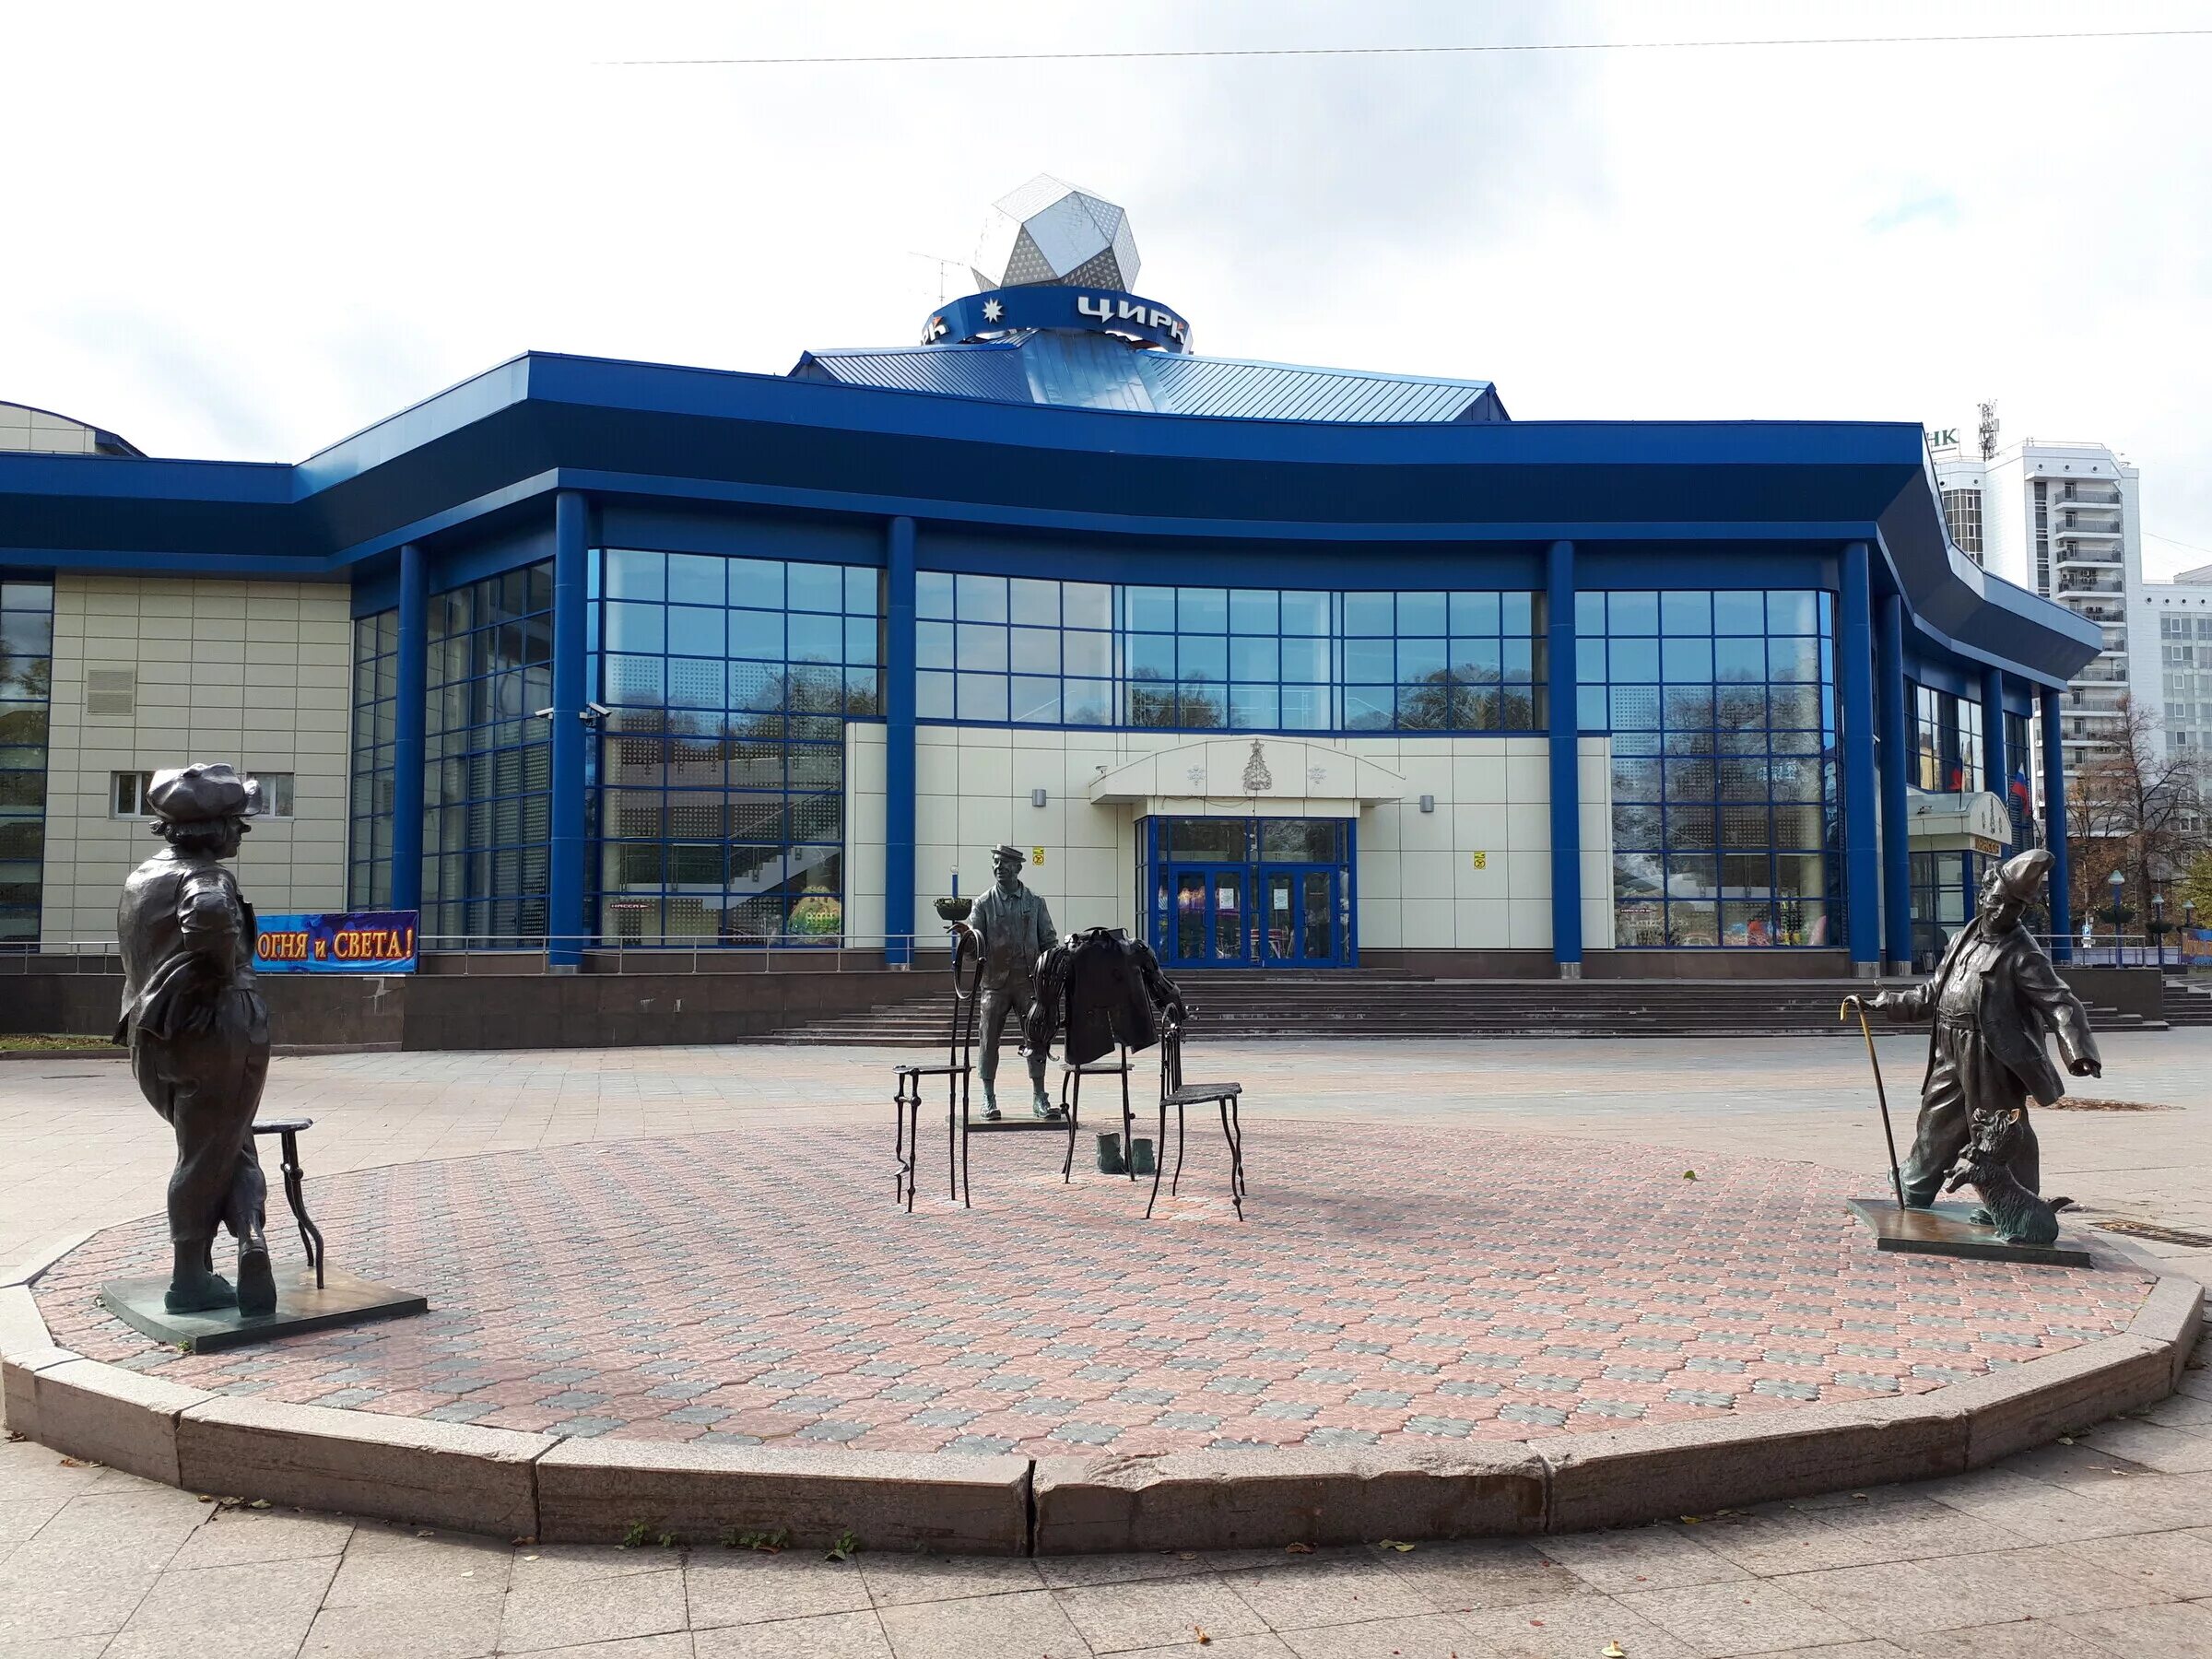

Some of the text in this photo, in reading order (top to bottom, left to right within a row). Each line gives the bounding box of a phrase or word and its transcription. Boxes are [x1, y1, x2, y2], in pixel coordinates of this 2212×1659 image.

[1077, 296, 1185, 346] ЦИРК
[256, 928, 414, 959] ОГНЯ и СВЕТА!
